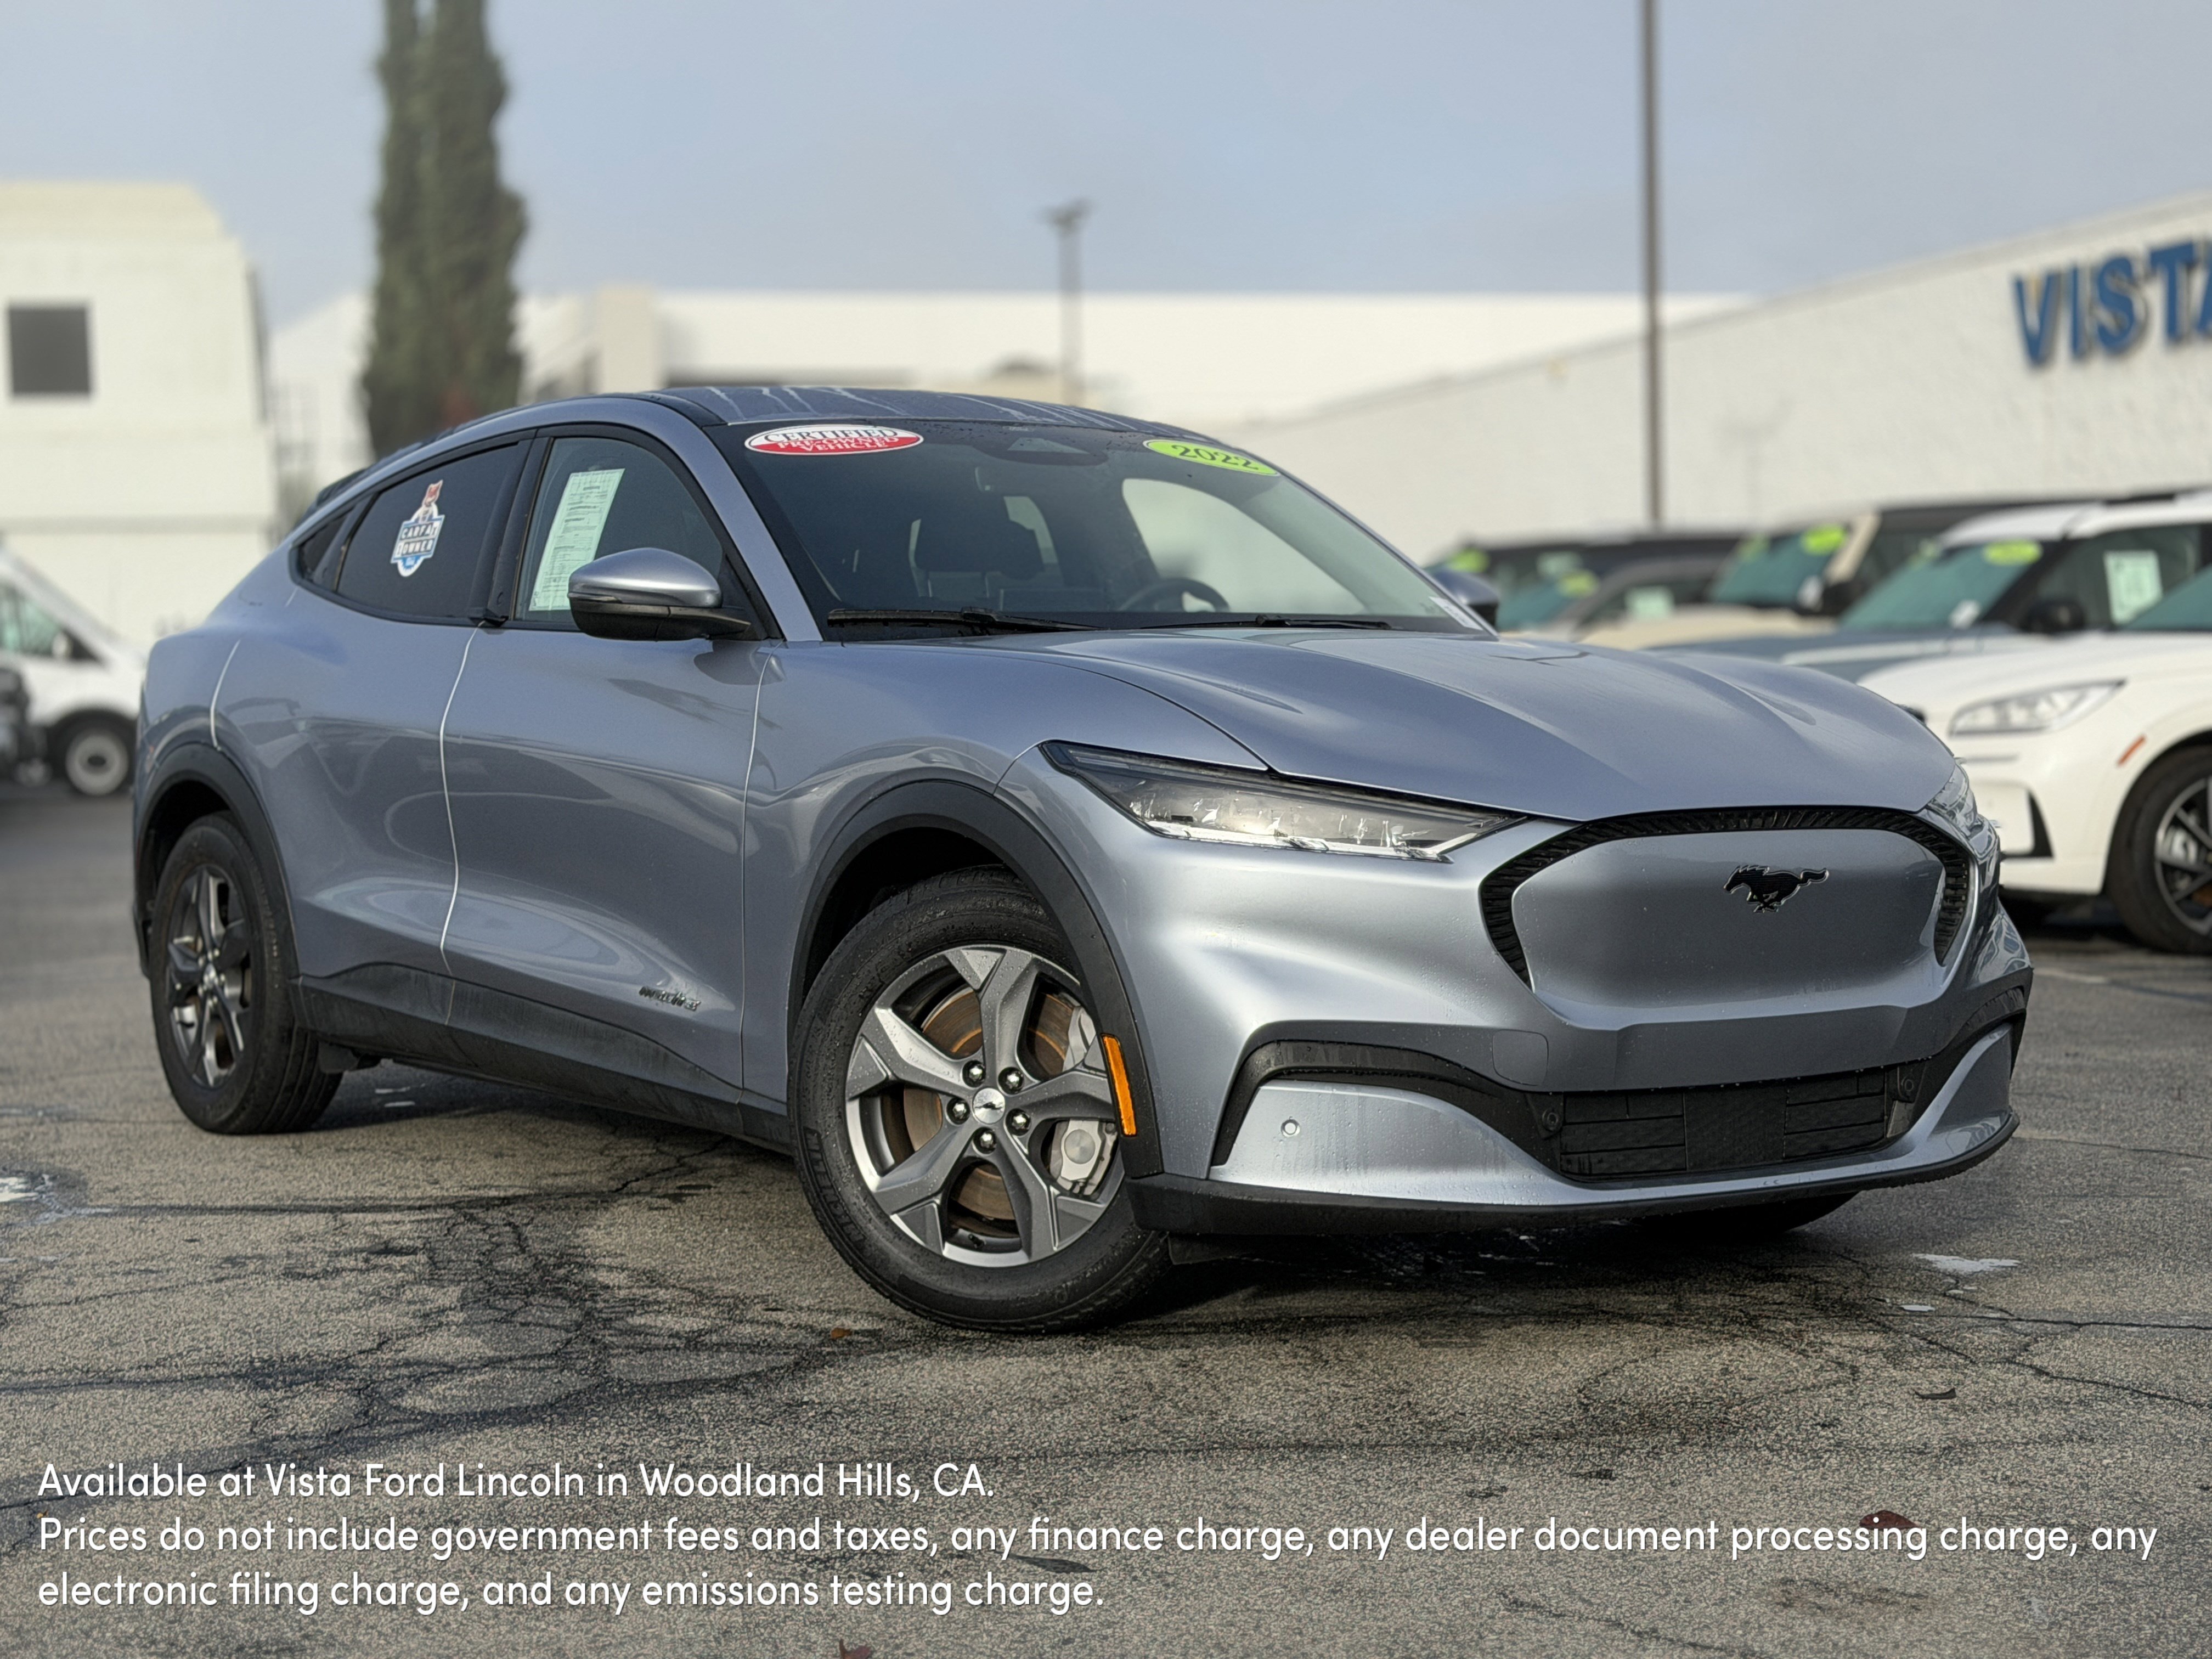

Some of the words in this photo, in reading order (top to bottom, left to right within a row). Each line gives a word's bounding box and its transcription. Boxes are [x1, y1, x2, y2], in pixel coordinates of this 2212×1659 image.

[764, 429, 898, 443] CERTIFIED
[777, 436, 900, 449] PRE-OWNED
[801, 440, 888, 452] VEHICLE
[1171, 444, 1259, 470] 2022
[805, 1132, 865, 1242] MICHELIN
